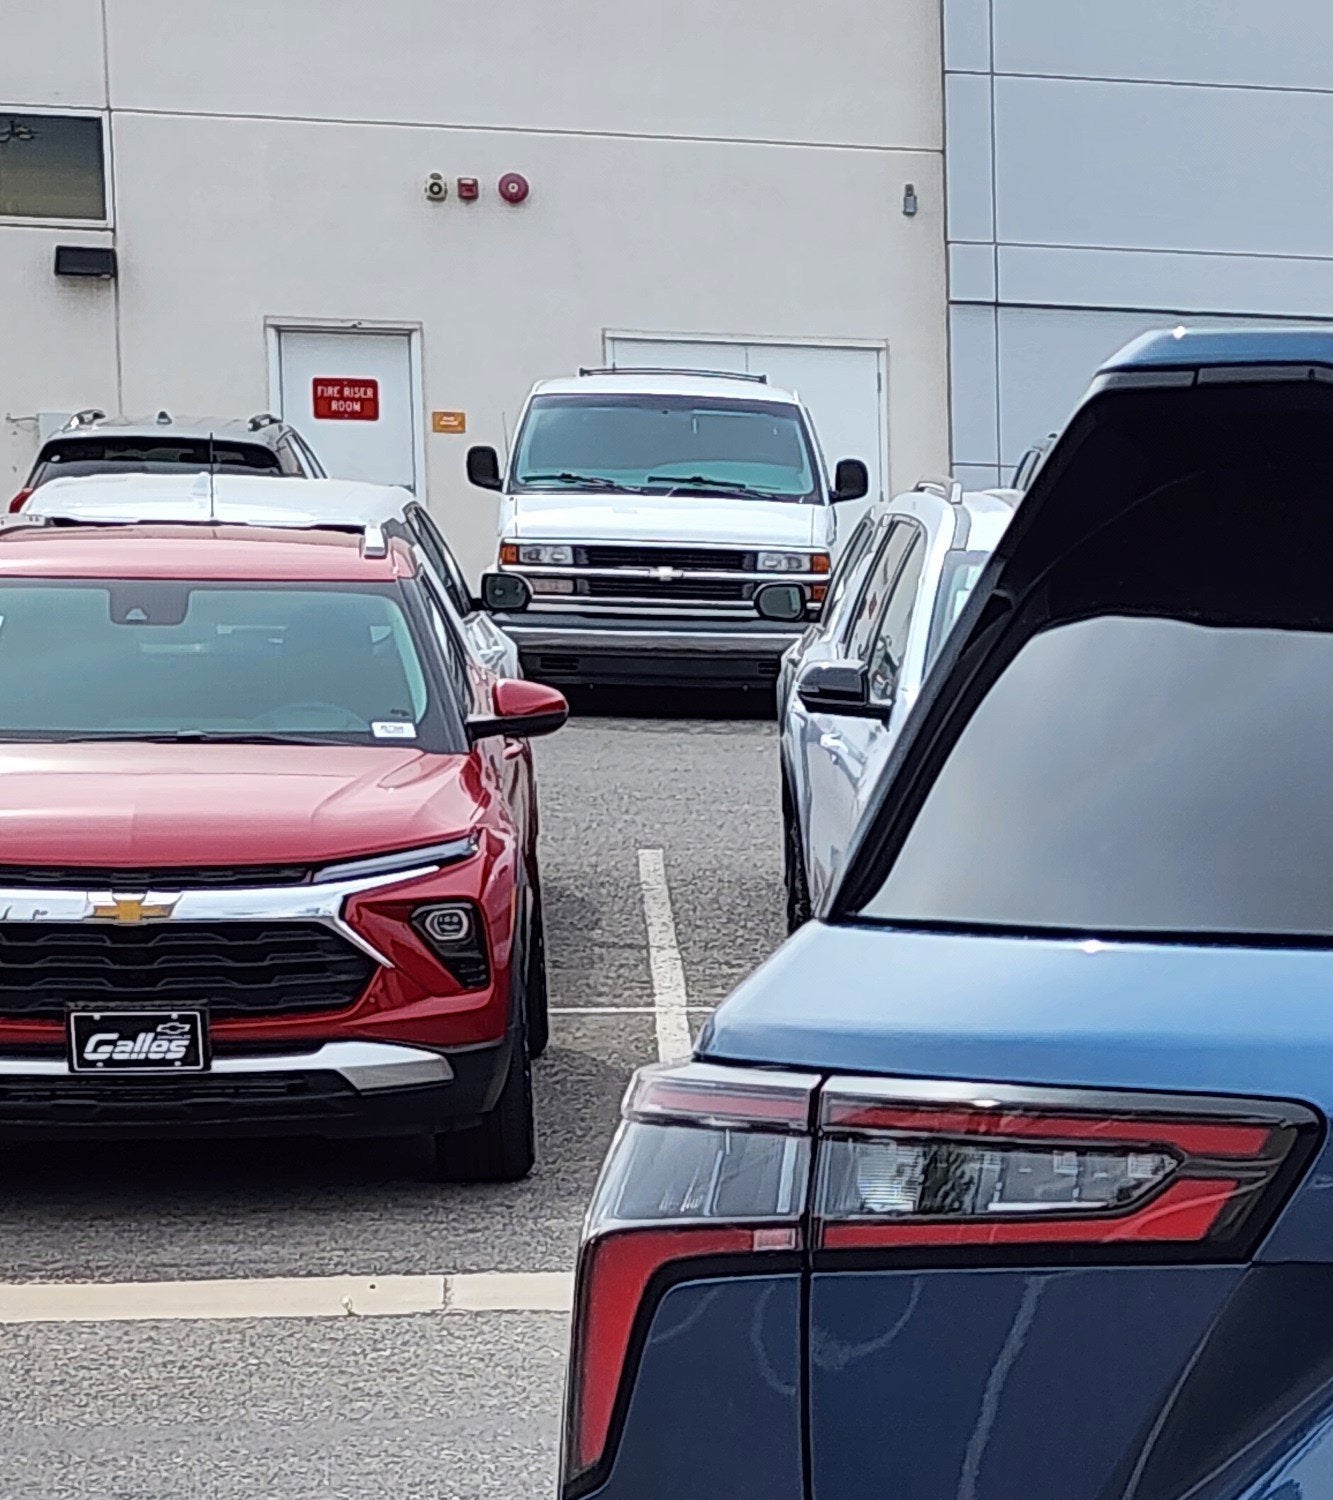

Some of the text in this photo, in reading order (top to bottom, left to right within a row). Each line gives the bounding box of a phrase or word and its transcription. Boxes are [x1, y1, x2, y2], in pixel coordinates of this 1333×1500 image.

[317, 385, 374, 399] FIRE RISER
[330, 399, 361, 412] ROOM
[83, 1032, 190, 1060] Galles
